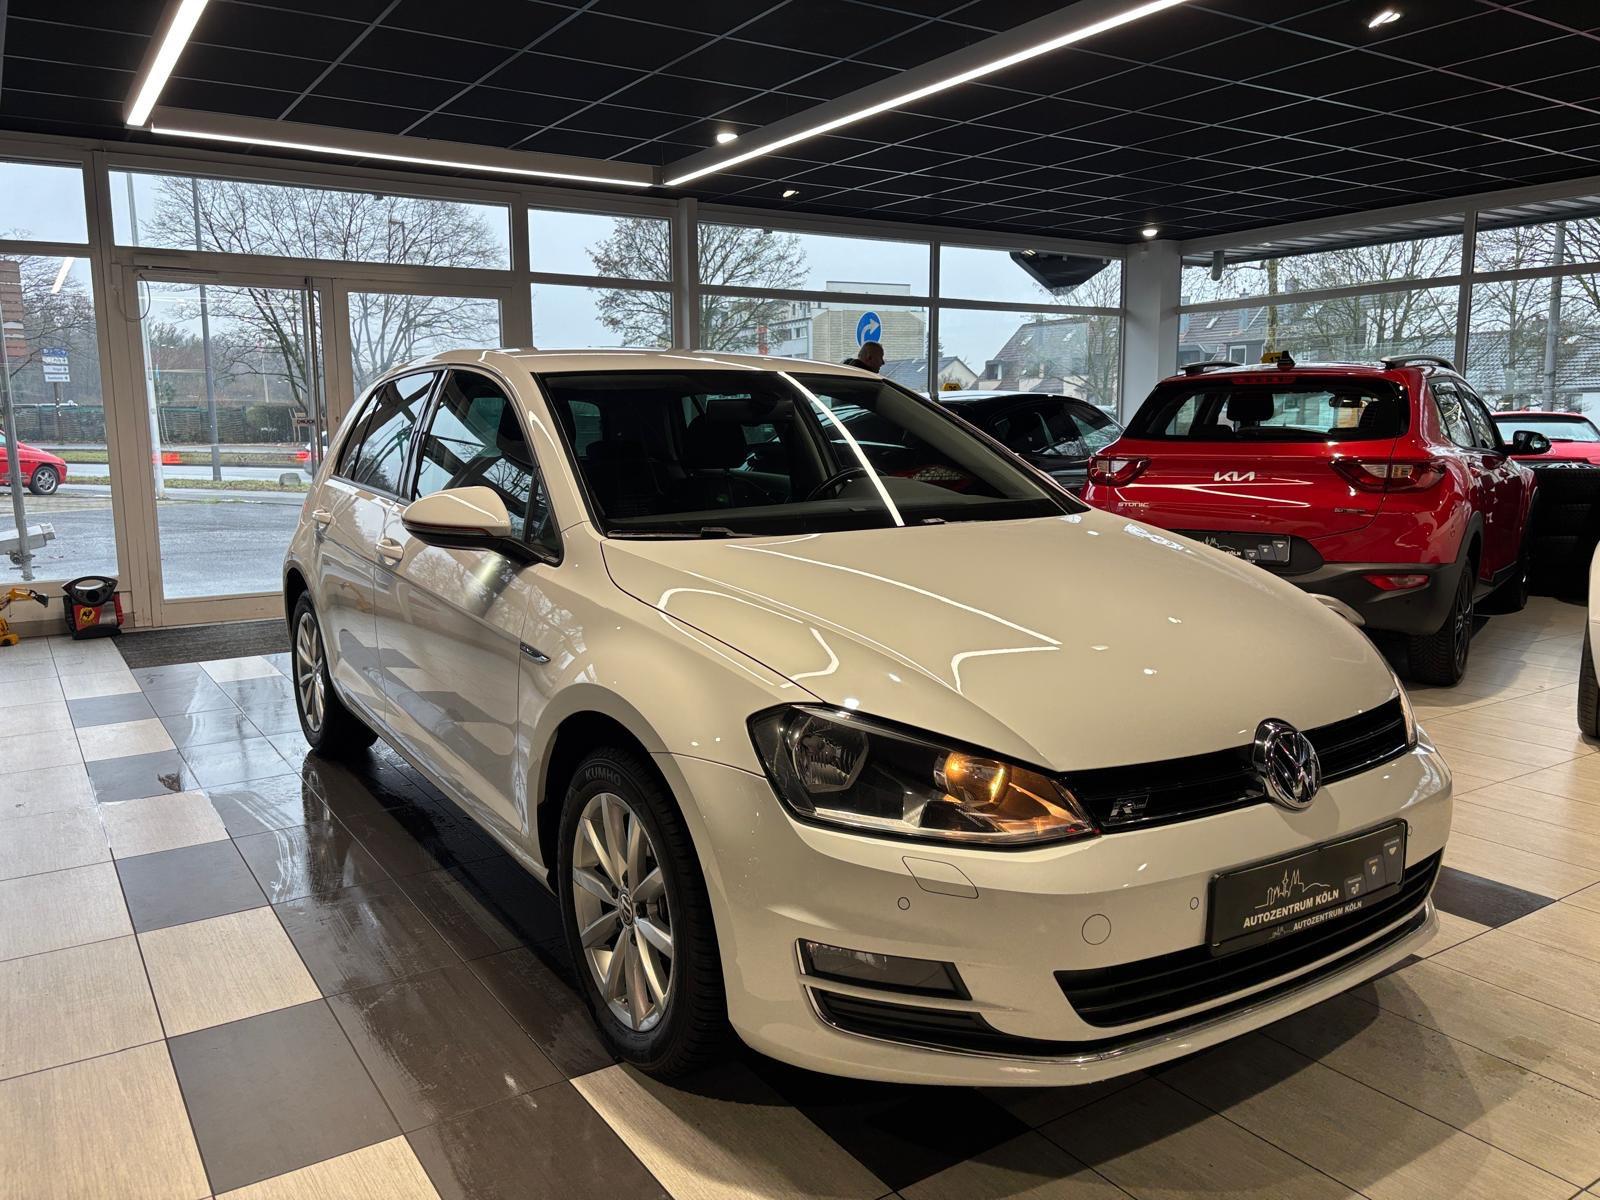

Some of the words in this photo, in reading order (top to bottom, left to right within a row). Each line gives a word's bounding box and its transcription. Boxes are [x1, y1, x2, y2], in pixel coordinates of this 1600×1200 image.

[1213, 471, 1256, 482] KIA
[585, 766, 621, 786] KUMHO
[1243, 897, 1314, 929] AUTOZENTRUM
[1315, 889, 1340, 906] KÖLN
[1293, 907, 1343, 931] AUTOZENTRUM
[1344, 901, 1363, 913] KÖLN
